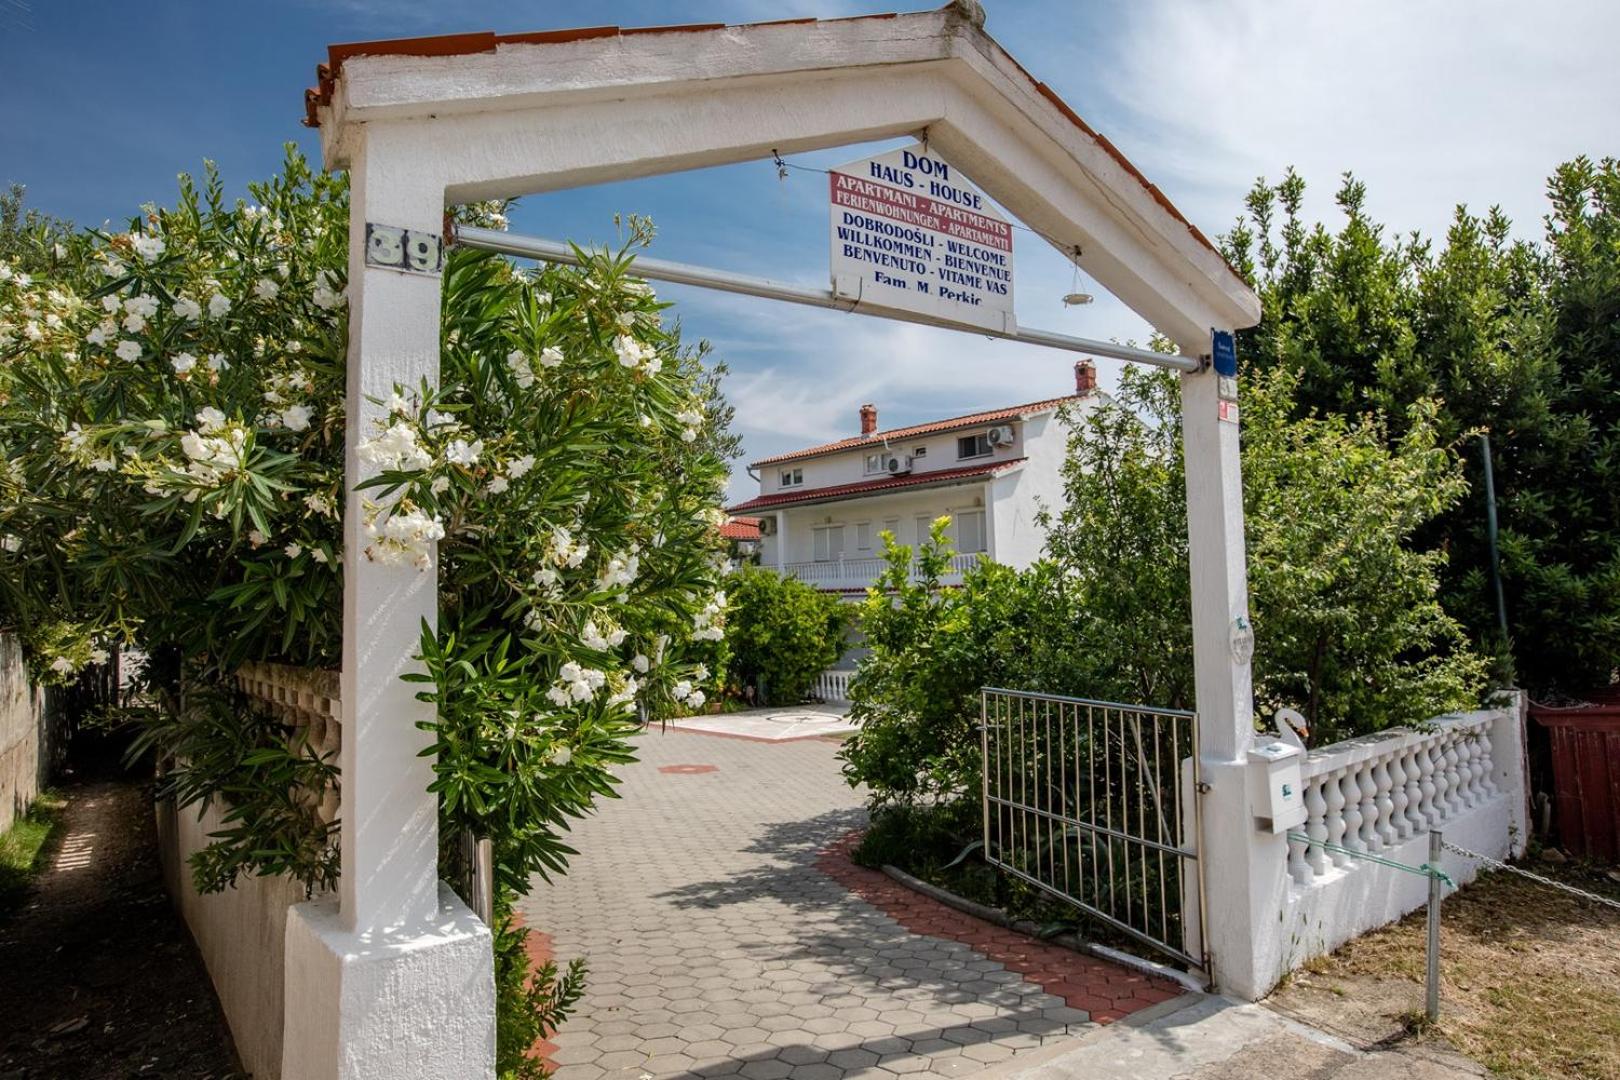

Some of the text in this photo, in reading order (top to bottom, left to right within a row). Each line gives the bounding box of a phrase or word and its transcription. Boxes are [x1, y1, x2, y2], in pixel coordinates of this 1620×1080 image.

[870, 161, 914, 188] HAUS
[930, 181, 981, 210] HOUSE
[903, 150, 948, 181] DOM
[836, 190, 940, 230] FERIENWOHNUNGEN
[837, 176, 917, 208] APARTMANI
[929, 201, 1007, 235] APARTMENTS
[837, 226, 932, 262] WILLKOMMEN
[945, 254, 1011, 282] BIENVENUE
[843, 212, 934, 247] DOBRODOŠLI
[947, 240, 1006, 267] WELCOME
[843, 244, 926, 275] BENVENUTO
[938, 267, 982, 290] VITAME
[986, 279, 1007, 296] VAS
